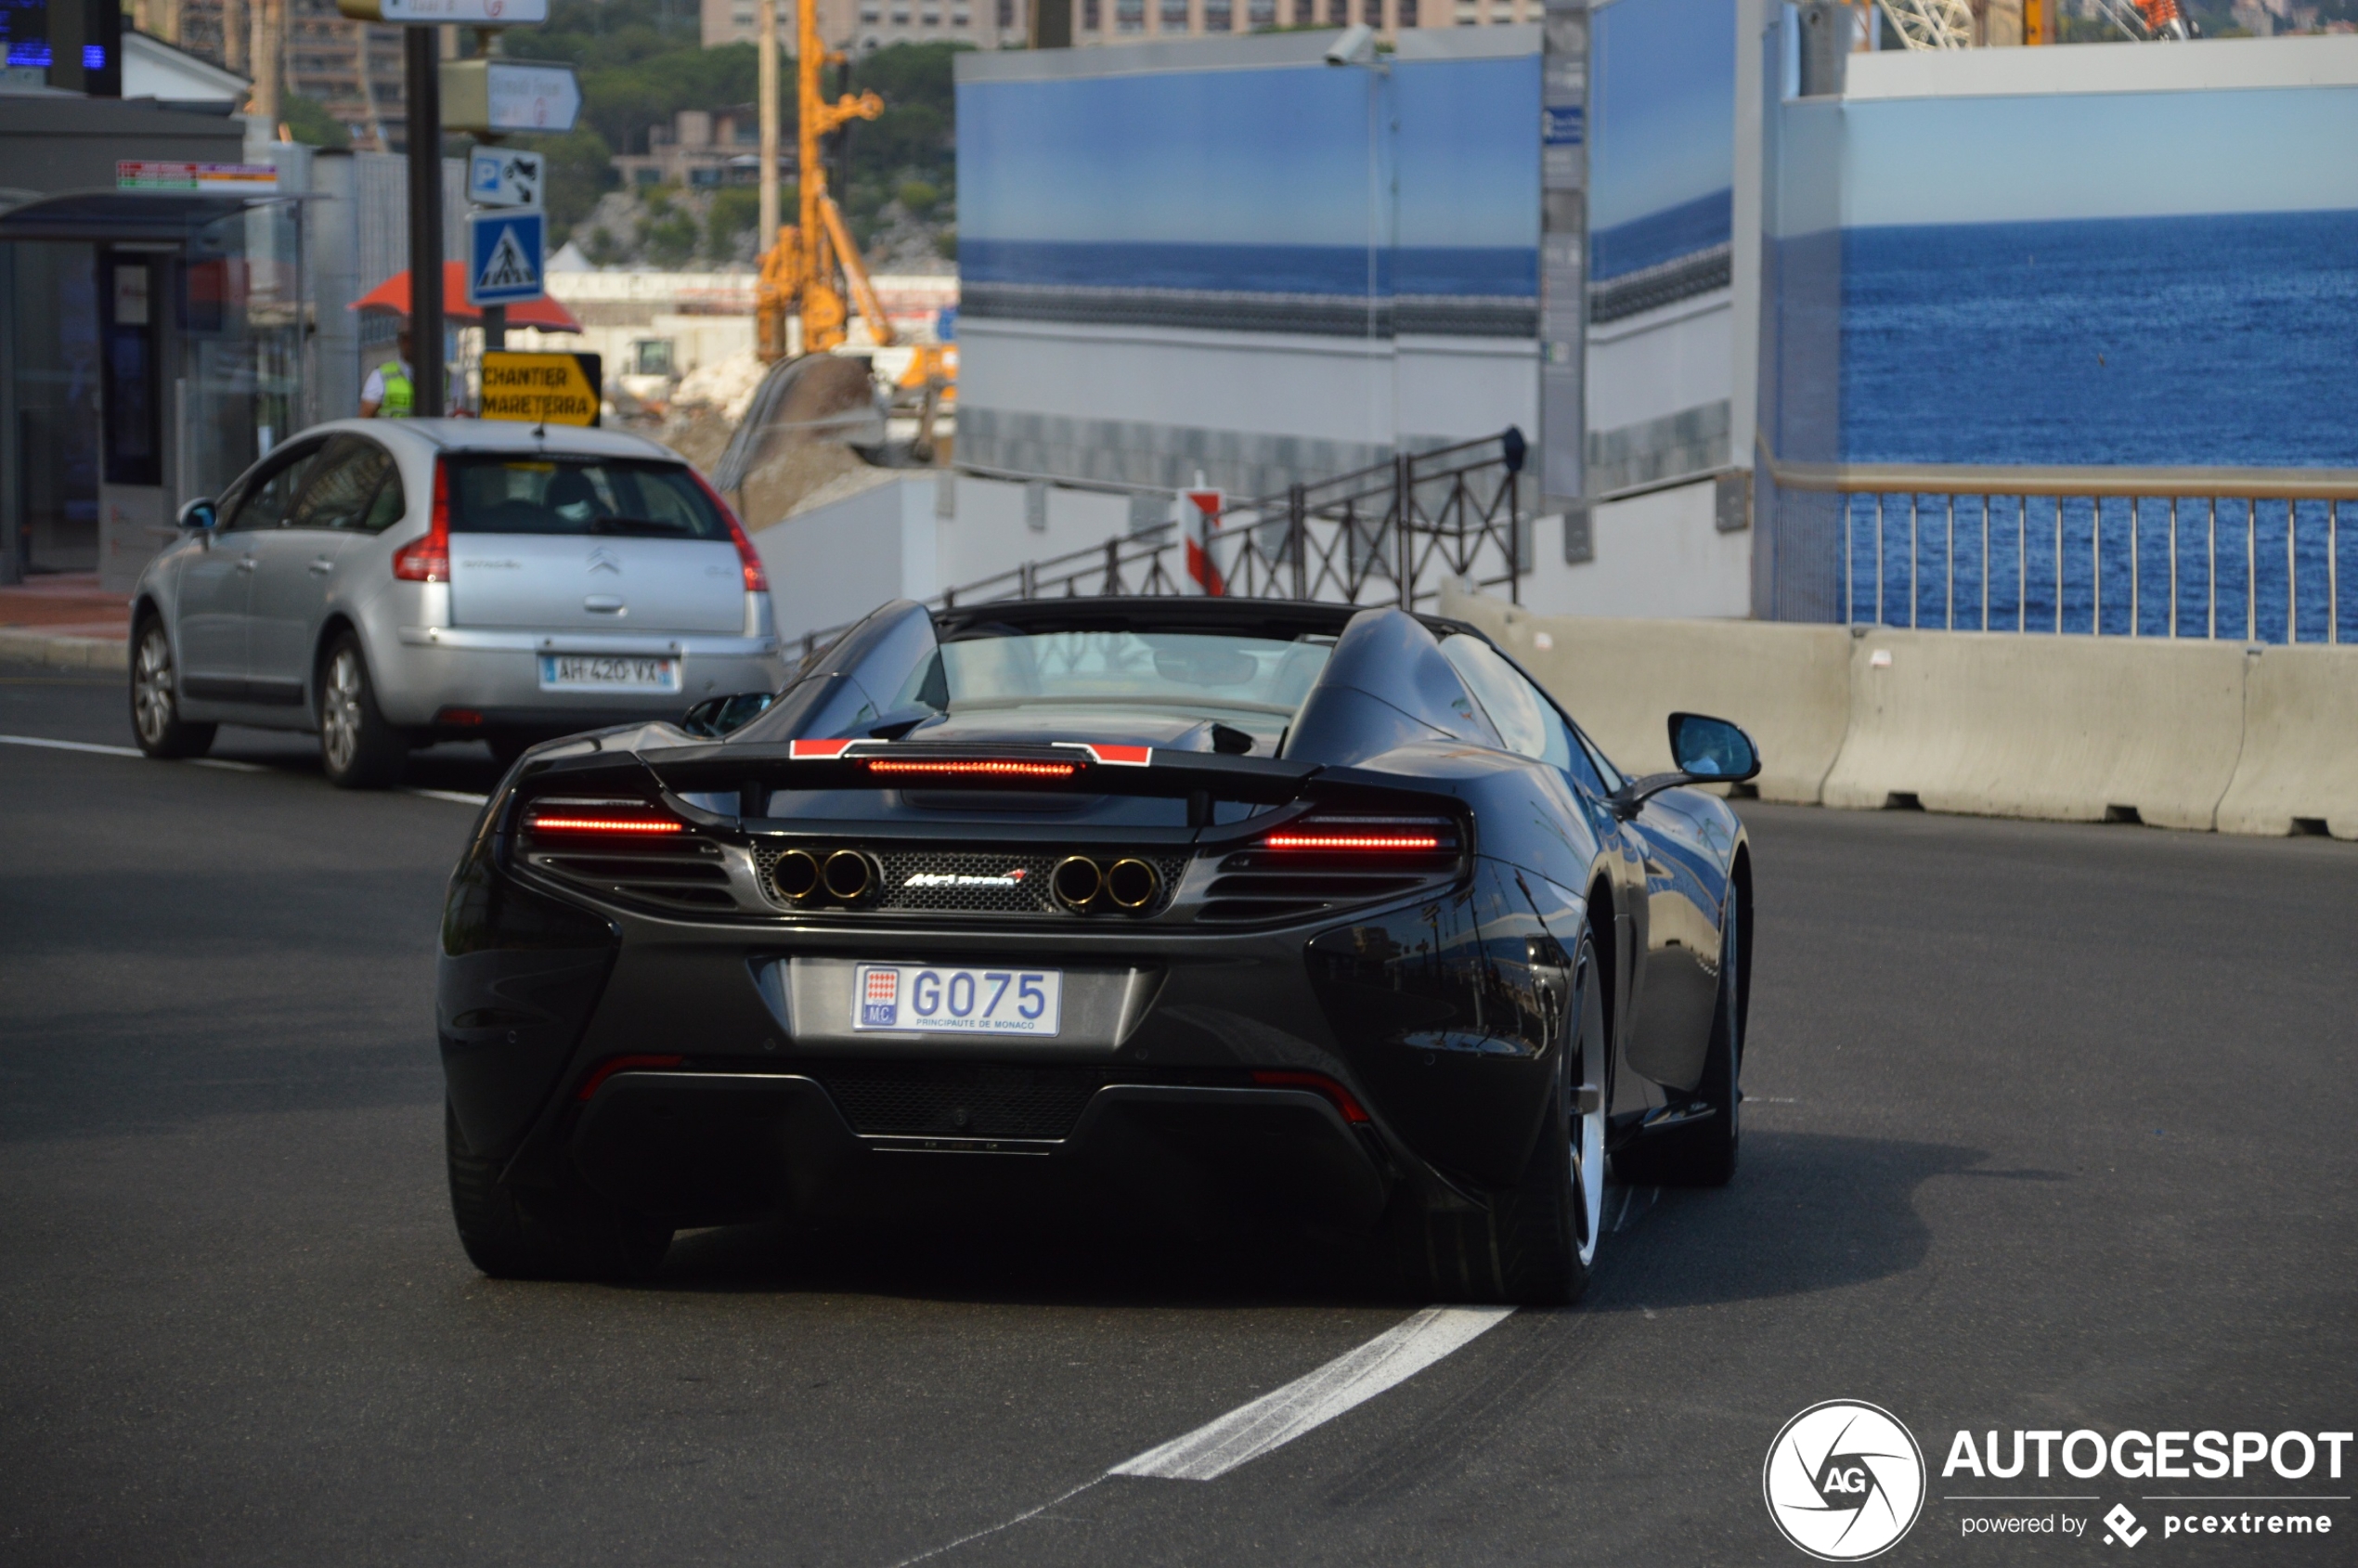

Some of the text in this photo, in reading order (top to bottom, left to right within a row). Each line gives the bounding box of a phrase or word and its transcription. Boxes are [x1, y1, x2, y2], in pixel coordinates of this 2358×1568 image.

[478, 163, 497, 186] P
[482, 366, 567, 387] CHANTIER
[481, 395, 589, 416] MARETERRA
[904, 873, 1016, 888] McLaren
[912, 971, 1044, 1019] G075
[869, 1006, 889, 1021] MC
[978, 1019, 991, 1028] DE
[994, 1020, 1034, 1030] MONACO
